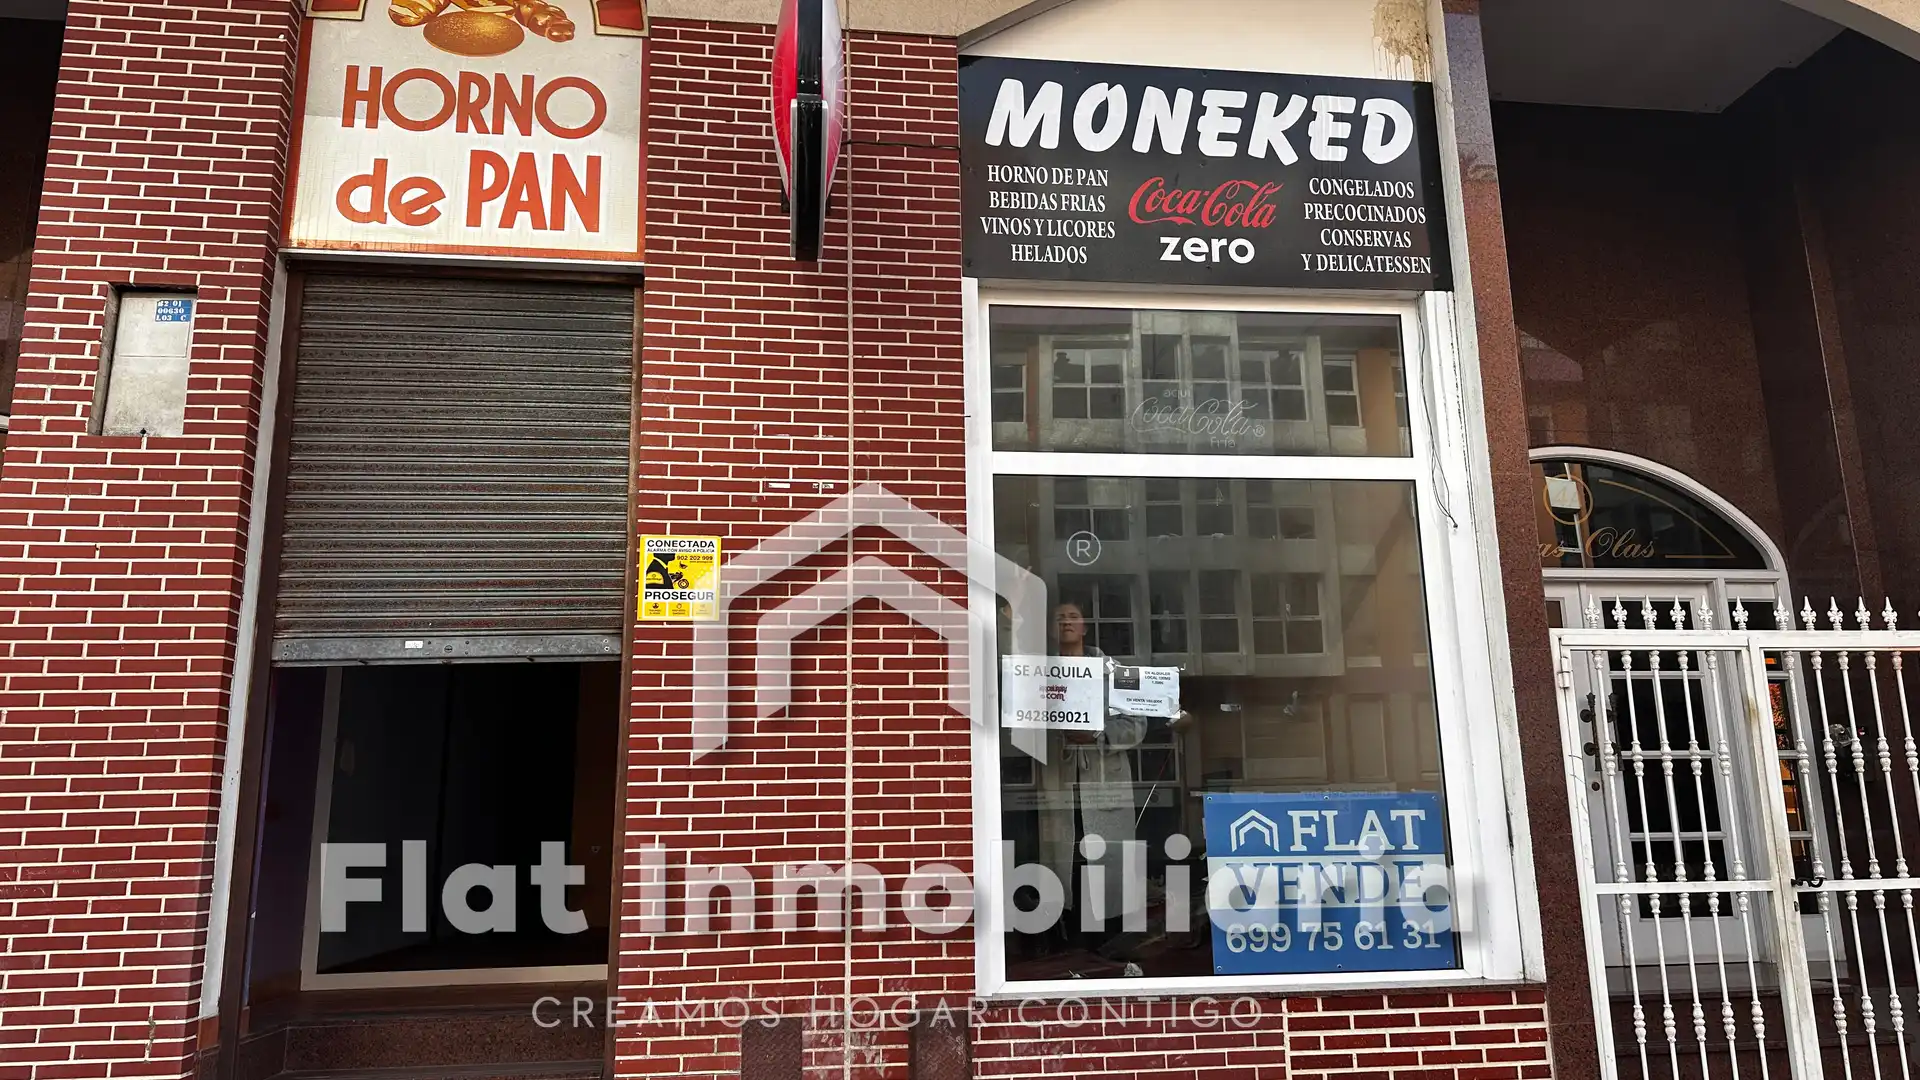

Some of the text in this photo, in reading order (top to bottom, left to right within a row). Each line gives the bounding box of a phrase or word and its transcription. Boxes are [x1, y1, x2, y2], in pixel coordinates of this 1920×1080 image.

[341, 65, 607, 138] HORNO
[985, 78, 1414, 166] MONEKED
[986, 164, 1109, 187] HORNO DE PAN
[335, 149, 601, 233] de PAN
[1308, 177, 1415, 199] CONGELADOS
[989, 190, 1106, 213] BEBIDAS FRIAS
[1128, 176, 1284, 229] Coca-Cola
[1303, 202, 1427, 225] PRECOCINADOS
[980, 215, 1116, 239] VINOS Y LICORES
[1159, 236, 1255, 265] zero
[1320, 229, 1412, 249] CONSERVAS
[1010, 243, 1088, 265] HELADOS
[1301, 253, 1432, 275] Y DELICATESSEN
[646, 539, 715, 548] CONECTADA
[1538, 526, 1655, 559] as Olas
[644, 590, 714, 601] PROSEGUR
[1014, 664, 1093, 679] SE ALQUILA
[1016, 709, 1090, 724] 942869021
[1287, 809, 1426, 851] FLAT
[1225, 860, 1425, 905] VENDE
[1226, 919, 1442, 953] 699 75 61 31
